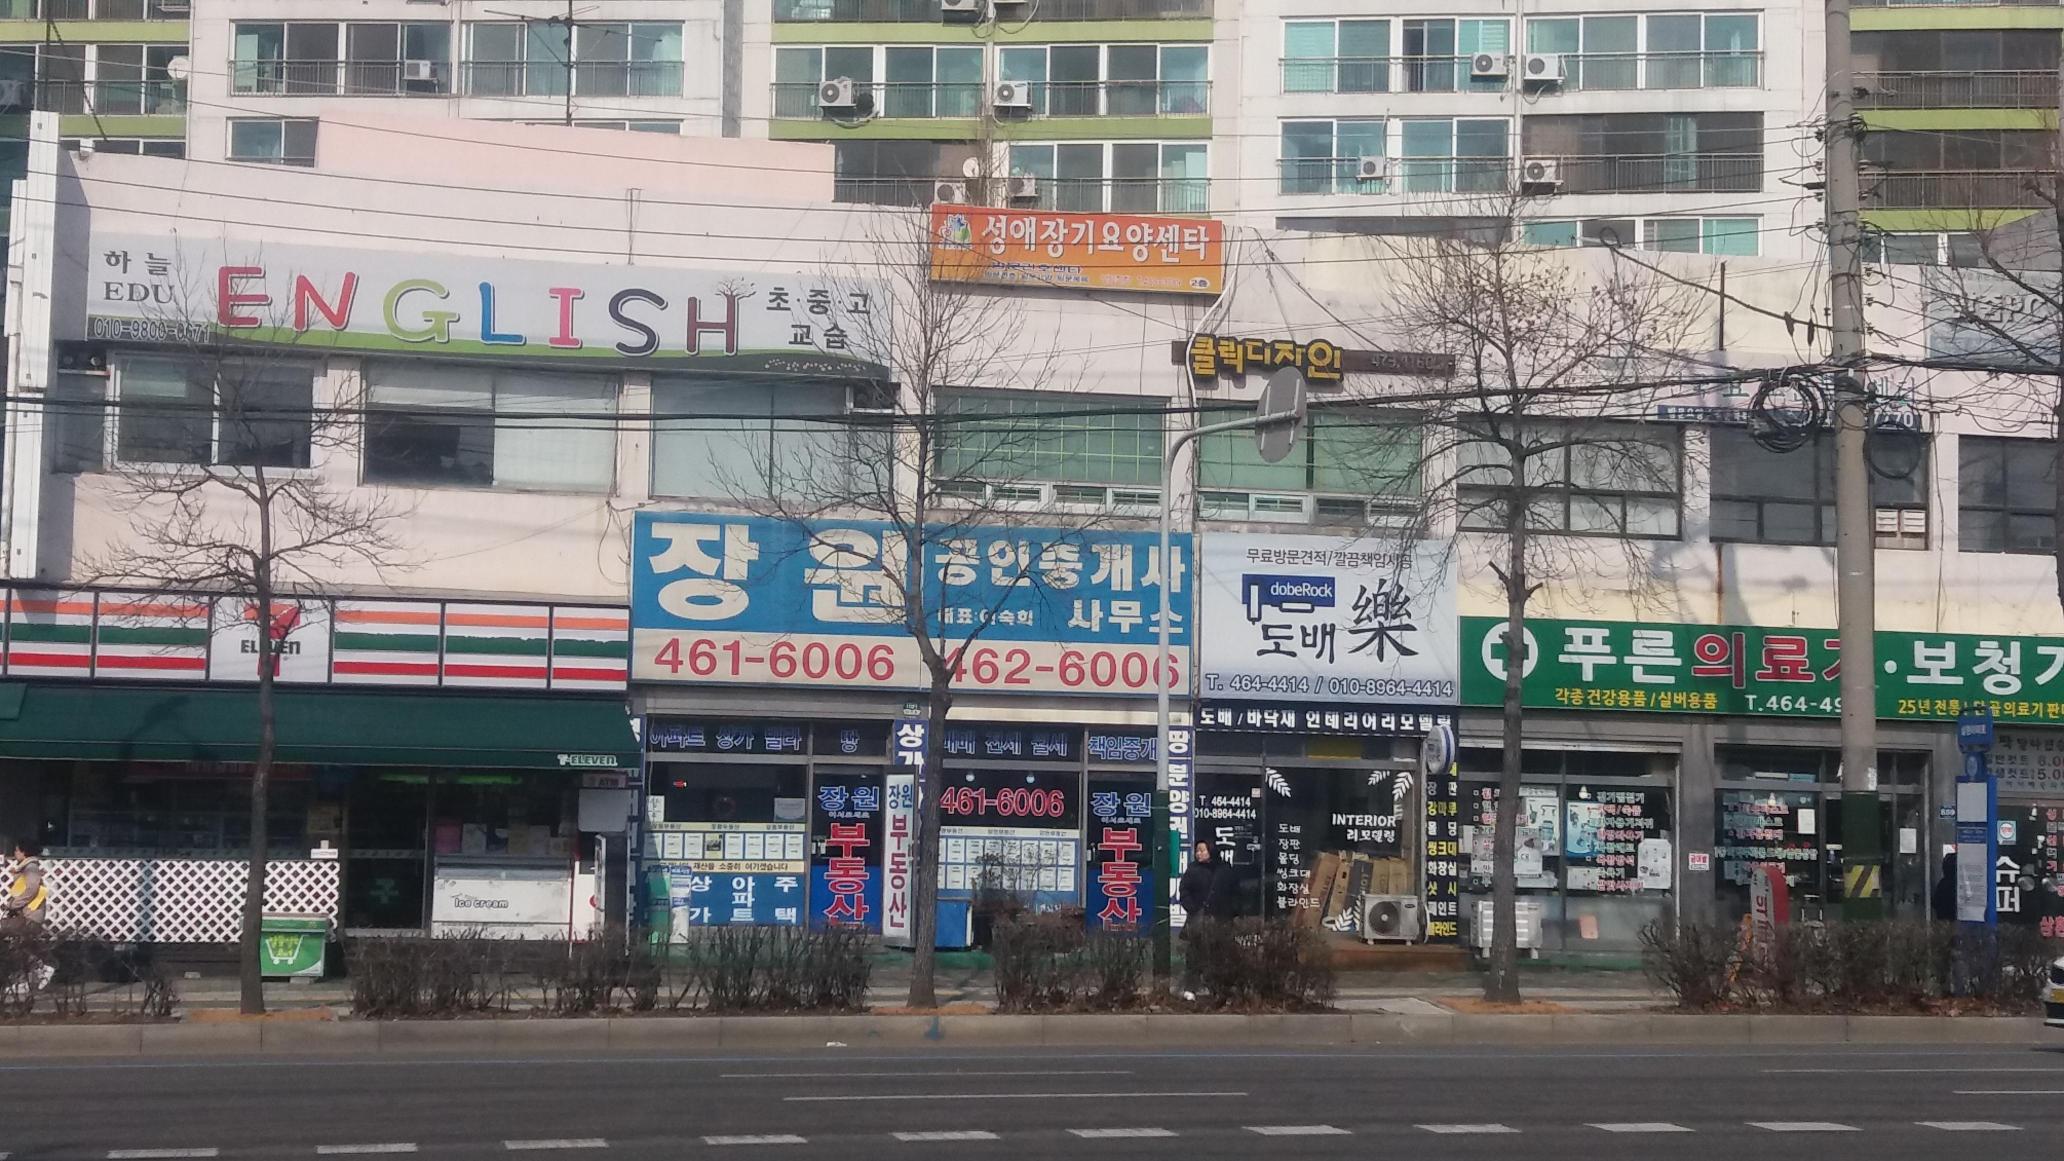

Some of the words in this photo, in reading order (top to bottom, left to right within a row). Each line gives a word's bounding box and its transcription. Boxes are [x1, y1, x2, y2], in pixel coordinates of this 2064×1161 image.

[981, 215, 1209, 263] 성애장기요양센터
[104, 250, 172, 277] 하늘
[104, 281, 174, 303] EDU
[218, 265, 740, 357] ENGLISH
[788, 325, 849, 350] 교습
[1190, 336, 1343, 380] 클릭디자인
[648, 522, 907, 624] 장원
[935, 538, 1186, 593] 공인중개사
[1270, 581, 1333, 598] dobeRock
[1068, 599, 1184, 634] 사무소
[1257, 622, 1336, 664] 도배
[1347, 578, 1419, 663] 樂
[654, 637, 895, 681] 461-6006
[944, 647, 1179, 689] 462-6006
[1206, 674, 1223, 690] T.
[1231, 675, 1309, 693] 464-4414
[1329, 679, 1454, 697] 010-8964-4414
[1555, 687, 1585, 704] 각종
[1587, 689, 1647, 707] 건강용품
[1658, 692, 1718, 709] 실버용품
[1899, 699, 1935, 715] 25년
[818, 786, 880, 811] 장원
[888, 783, 913, 809] 장원
[940, 786, 1065, 817] 461-6006
[1090, 791, 1151, 817] 장원
[1211, 796, 1251, 807] 464-4414
[1278, 824, 1301, 834] 도배
[1332, 813, 1397, 827] INTERIOR
[1278, 838, 1301, 850] 장판
[1346, 829, 1395, 843] 리모델링
[823, 823, 871, 928] 부동산
[889, 814, 908, 928] 부동산
[1097, 827, 1143, 932] 부동산
[1427, 861, 1457, 876] 화장실
[730, 876, 756, 922] 아파트
[774, 876, 799, 923] 주택
[1276, 881, 1310, 895] 화장실
[476, 899, 508, 908] cream
